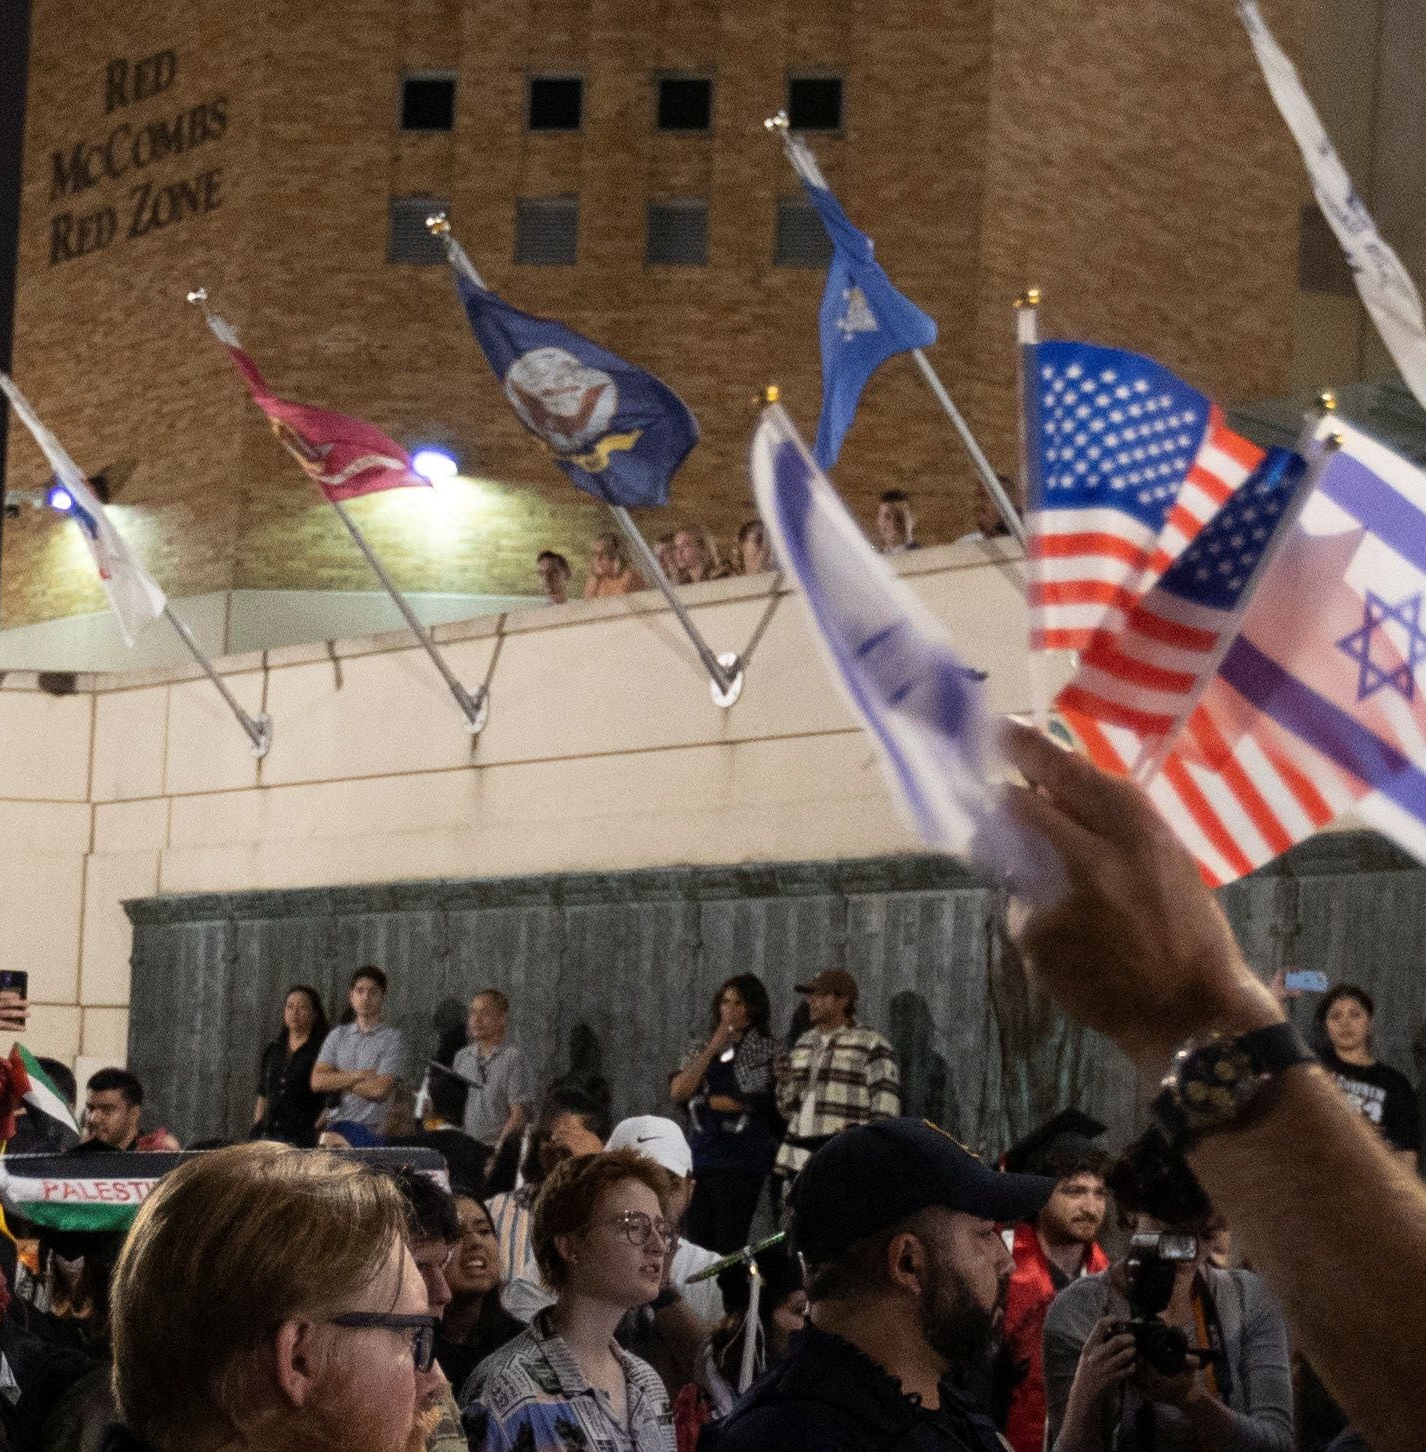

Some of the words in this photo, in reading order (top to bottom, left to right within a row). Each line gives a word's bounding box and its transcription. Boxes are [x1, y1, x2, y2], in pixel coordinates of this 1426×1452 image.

[106, 51, 175, 114] RED
[50, 209, 117, 264] RED
[127, 170, 223, 239] ZONE
